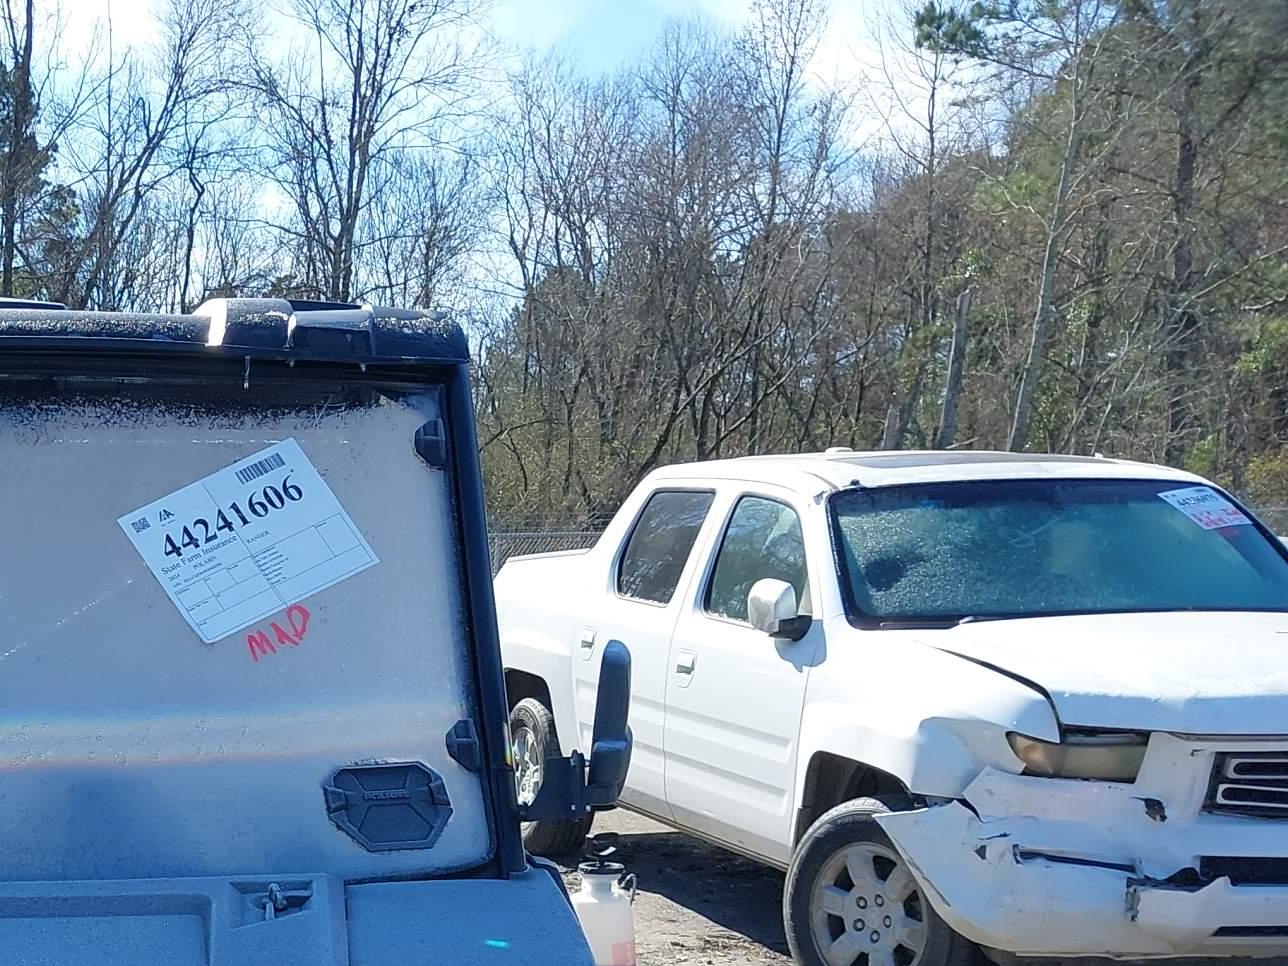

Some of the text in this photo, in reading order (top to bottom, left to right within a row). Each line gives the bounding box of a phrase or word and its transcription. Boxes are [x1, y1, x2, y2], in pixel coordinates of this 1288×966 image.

[163, 474, 304, 558] 44241606
[160, 534, 238, 575] State Farm Insurance
[192, 555, 218, 571] POLARIS
[247, 603, 311, 662] MAD
